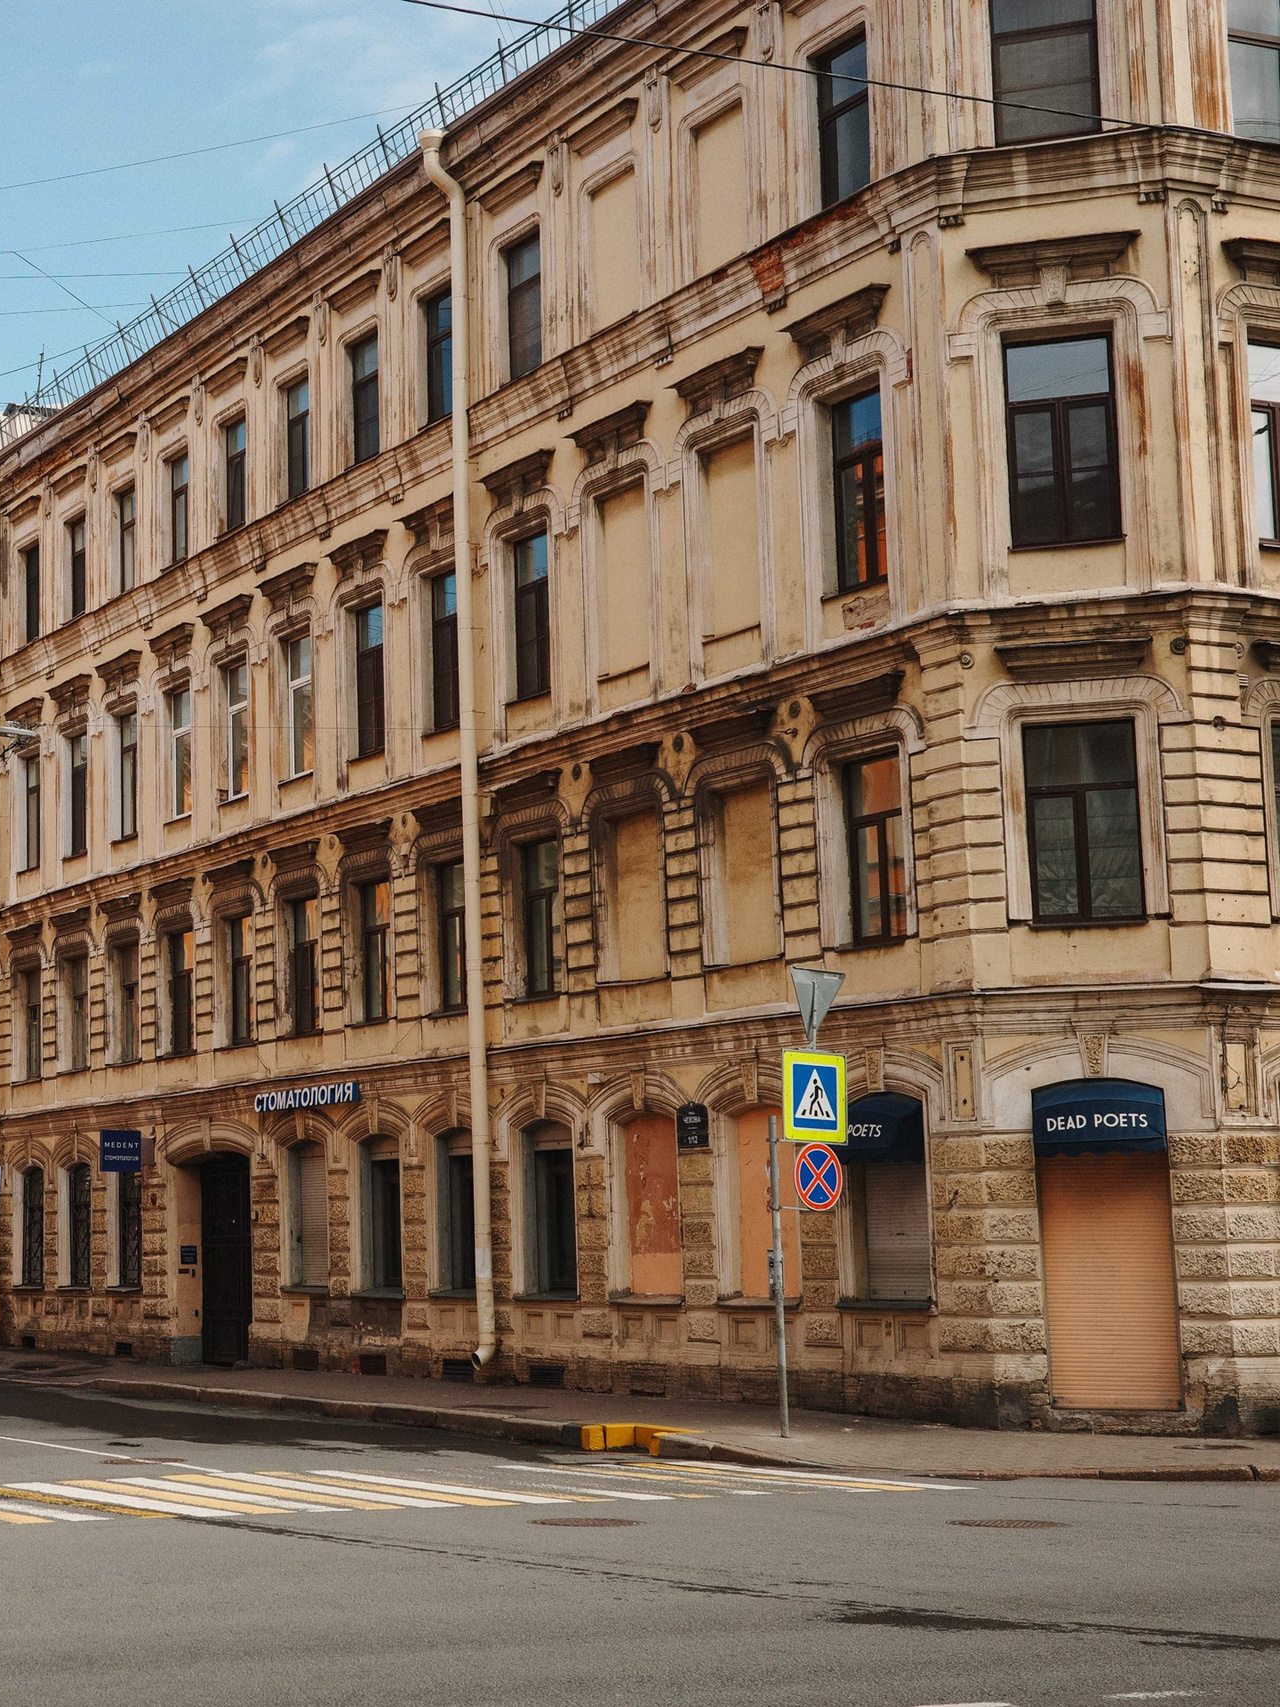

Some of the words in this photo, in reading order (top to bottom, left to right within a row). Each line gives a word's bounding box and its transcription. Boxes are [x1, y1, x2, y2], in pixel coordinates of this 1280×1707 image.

[254, 1082, 353, 1112] СТОМАТОЛОГИЯ
[848, 1124, 882, 1137] POETS
[1046, 1115, 1087, 1132] DEAD
[1094, 1113, 1148, 1128] POETS
